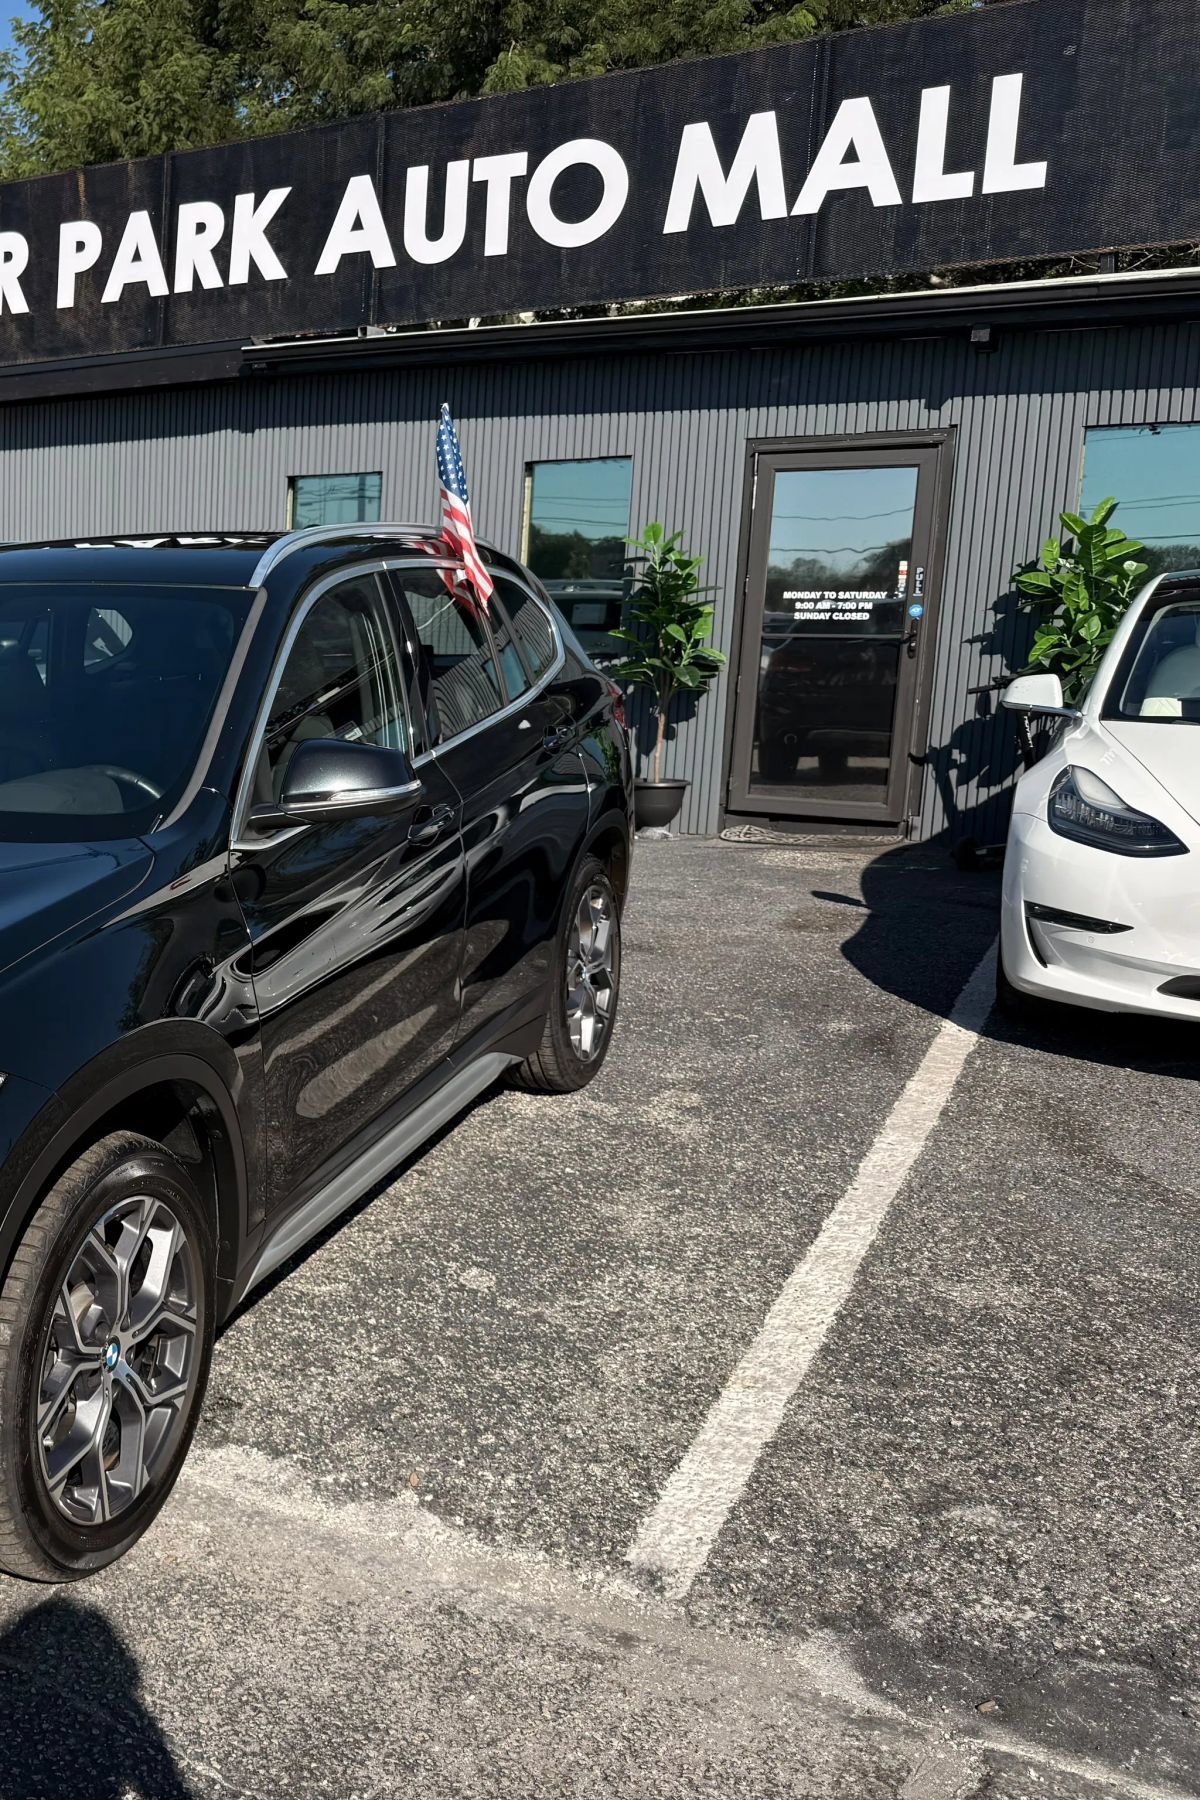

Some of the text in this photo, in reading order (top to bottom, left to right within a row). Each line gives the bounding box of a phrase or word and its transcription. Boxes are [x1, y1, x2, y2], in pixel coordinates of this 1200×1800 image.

[56, 187, 292, 309] PARK
[313, 138, 629, 276] AUTO
[662, 73, 1047, 235] MALL
[915, 567, 924, 594] PULL
[783, 591, 887, 599] MONDAY TO SATURDAY
[795, 602, 814, 610] 9:00
[816, 602, 831, 610] AM
[837, 602, 857, 610] 7:00
[858, 602, 873, 610] PM
[794, 612, 869, 620] SUNDAY CLOSED
